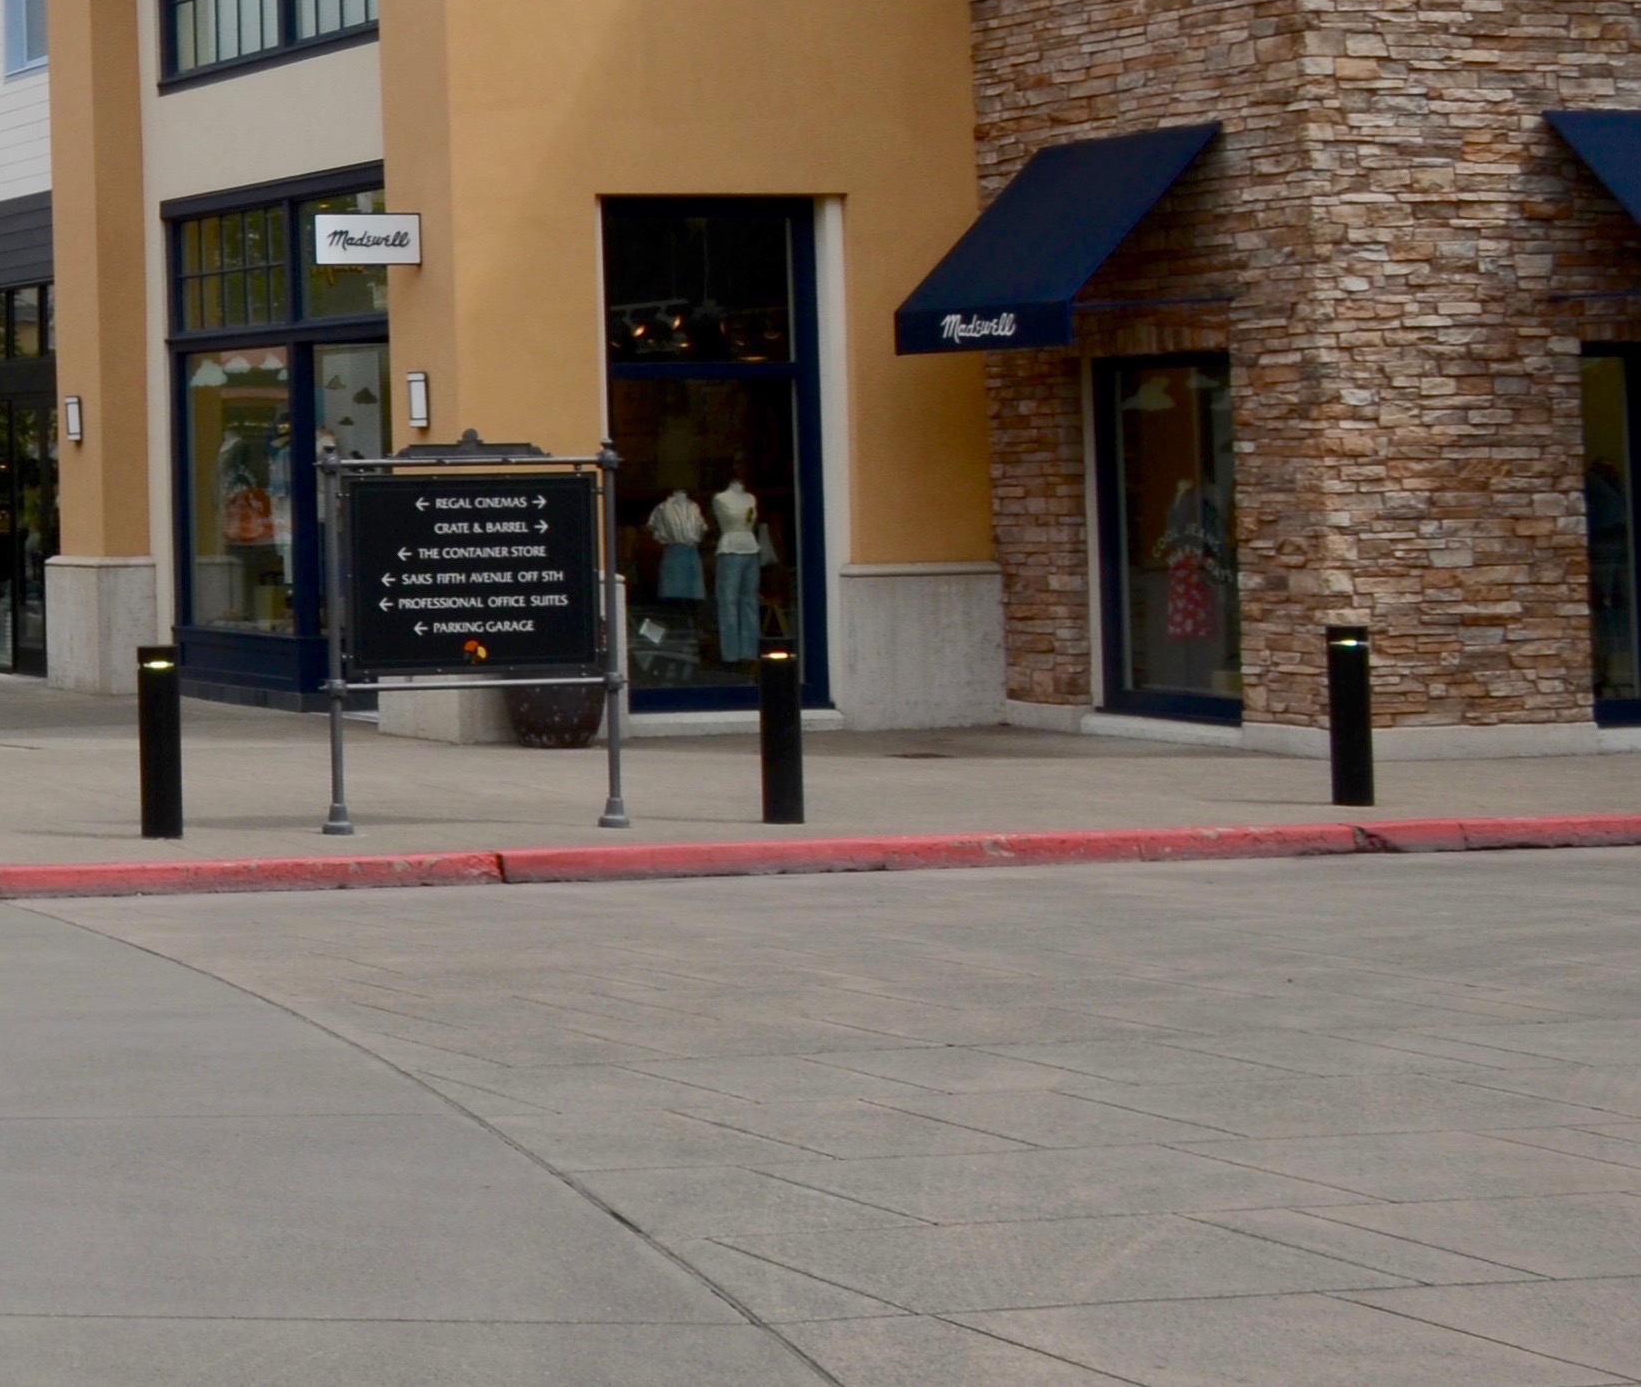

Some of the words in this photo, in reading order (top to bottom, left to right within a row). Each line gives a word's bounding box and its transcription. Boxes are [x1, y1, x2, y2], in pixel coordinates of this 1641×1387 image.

[326, 229, 411, 252] Madewell
[940, 312, 1016, 344] Madewell
[435, 498, 472, 509] REGAL
[474, 497, 527, 508] CINEMAS
[434, 523, 469, 534] CRATE
[473, 523, 483, 533] &
[486, 522, 528, 533] BARREL
[418, 548, 440, 559] THE
[442, 547, 509, 559] CONTAINER
[511, 546, 547, 557] STORE
[402, 573, 433, 585] SAKS
[436, 573, 466, 584] FIFTH
[469, 572, 513, 583] AVENUE
[517, 571, 539, 582] OFF
[541, 571, 564, 582] 5TH
[398, 597, 484, 609] PROFESSIONAL
[488, 596, 526, 607] OFFICE
[530, 594, 569, 606] SUITES
[433, 621, 484, 633] PARKING
[486, 620, 535, 632] GARAGE
